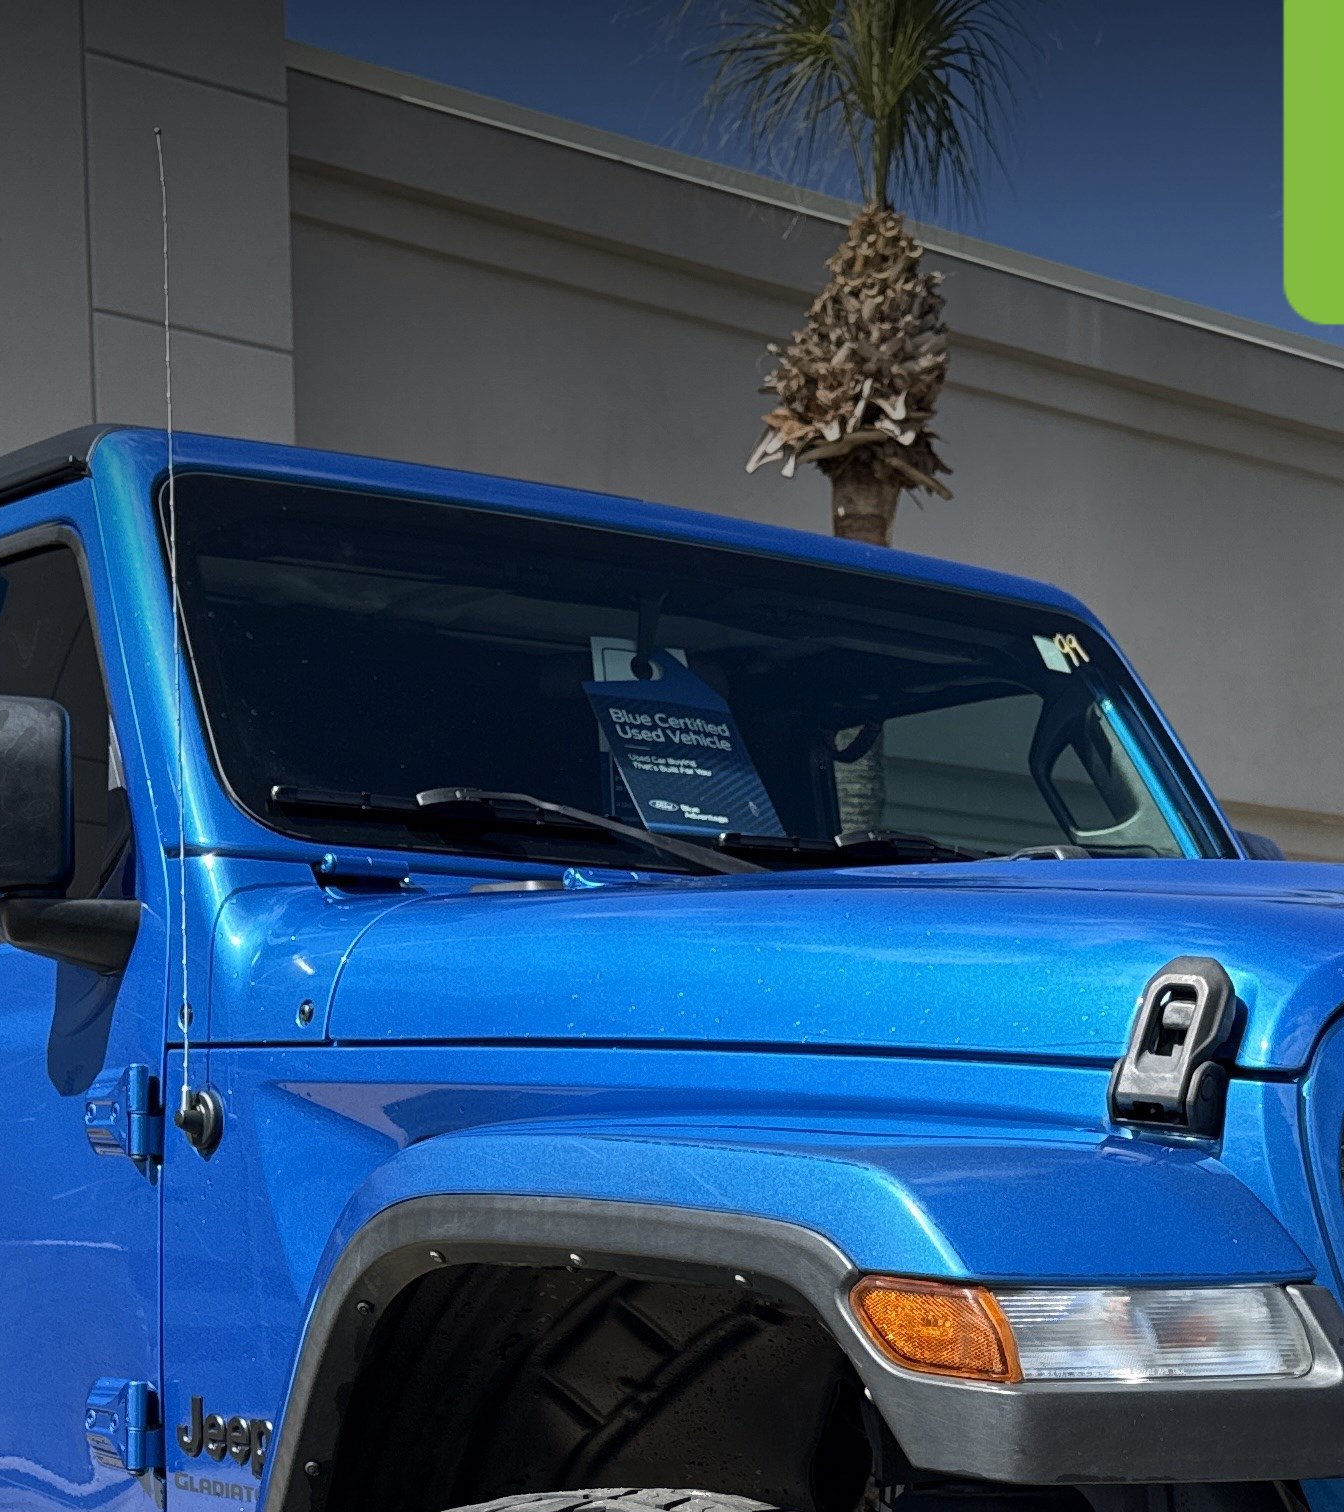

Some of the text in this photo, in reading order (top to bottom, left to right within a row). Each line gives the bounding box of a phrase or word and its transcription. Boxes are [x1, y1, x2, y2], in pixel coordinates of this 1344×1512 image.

[609, 708, 731, 737] Blue Certified
[616, 725, 732, 751] Used Vehicle
[177, 1394, 273, 1479] Jeep
[174, 1471, 259, 1503] GLADIAT
